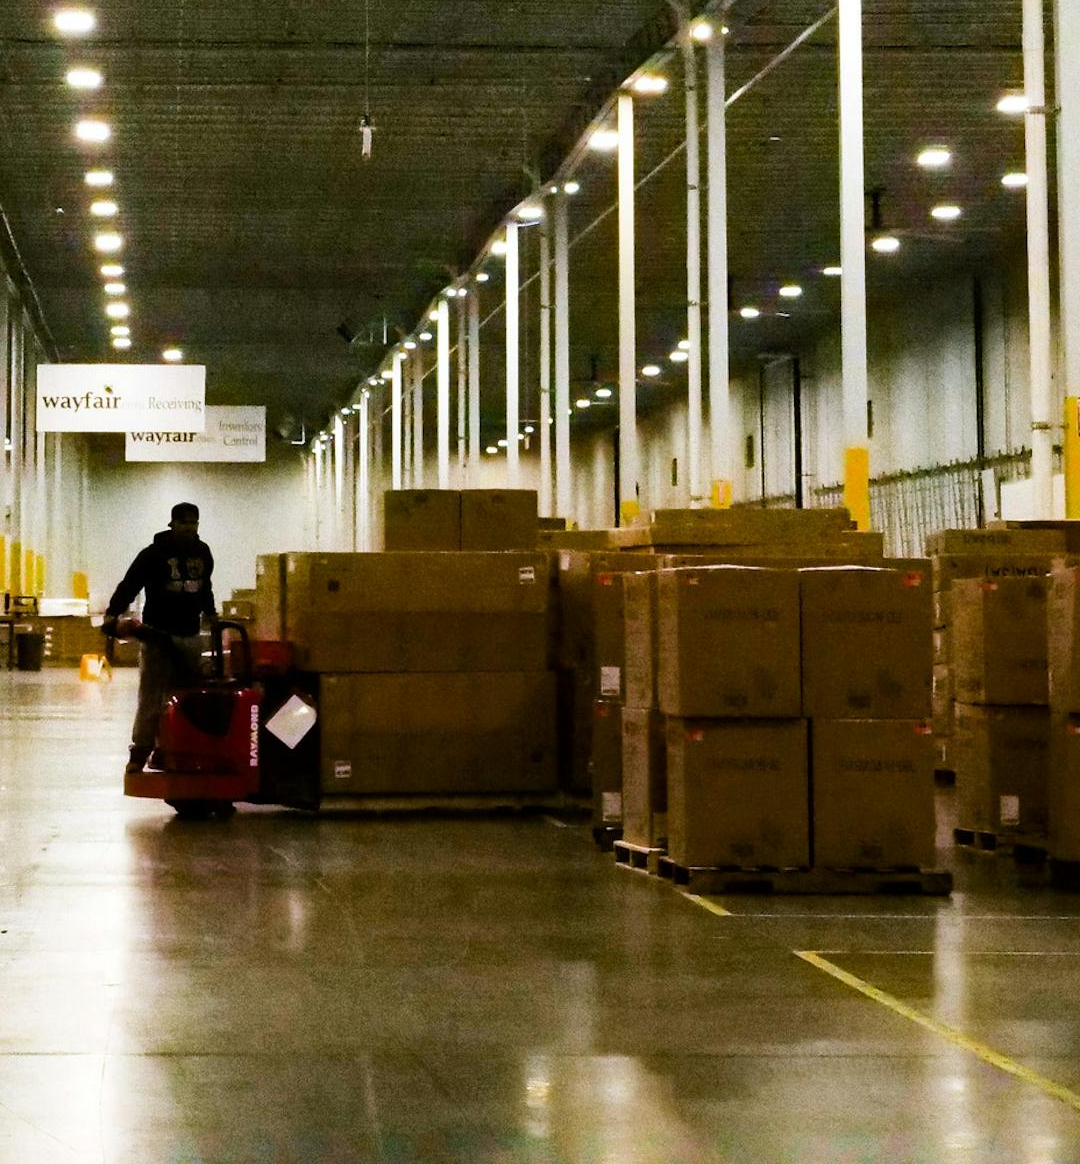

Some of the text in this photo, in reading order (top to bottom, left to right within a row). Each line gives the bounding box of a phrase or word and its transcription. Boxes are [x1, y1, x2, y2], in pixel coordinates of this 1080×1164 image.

[148, 396, 203, 413] Receiving
[223, 435, 258, 446] Control
[249, 704, 260, 767] RAYMOND
